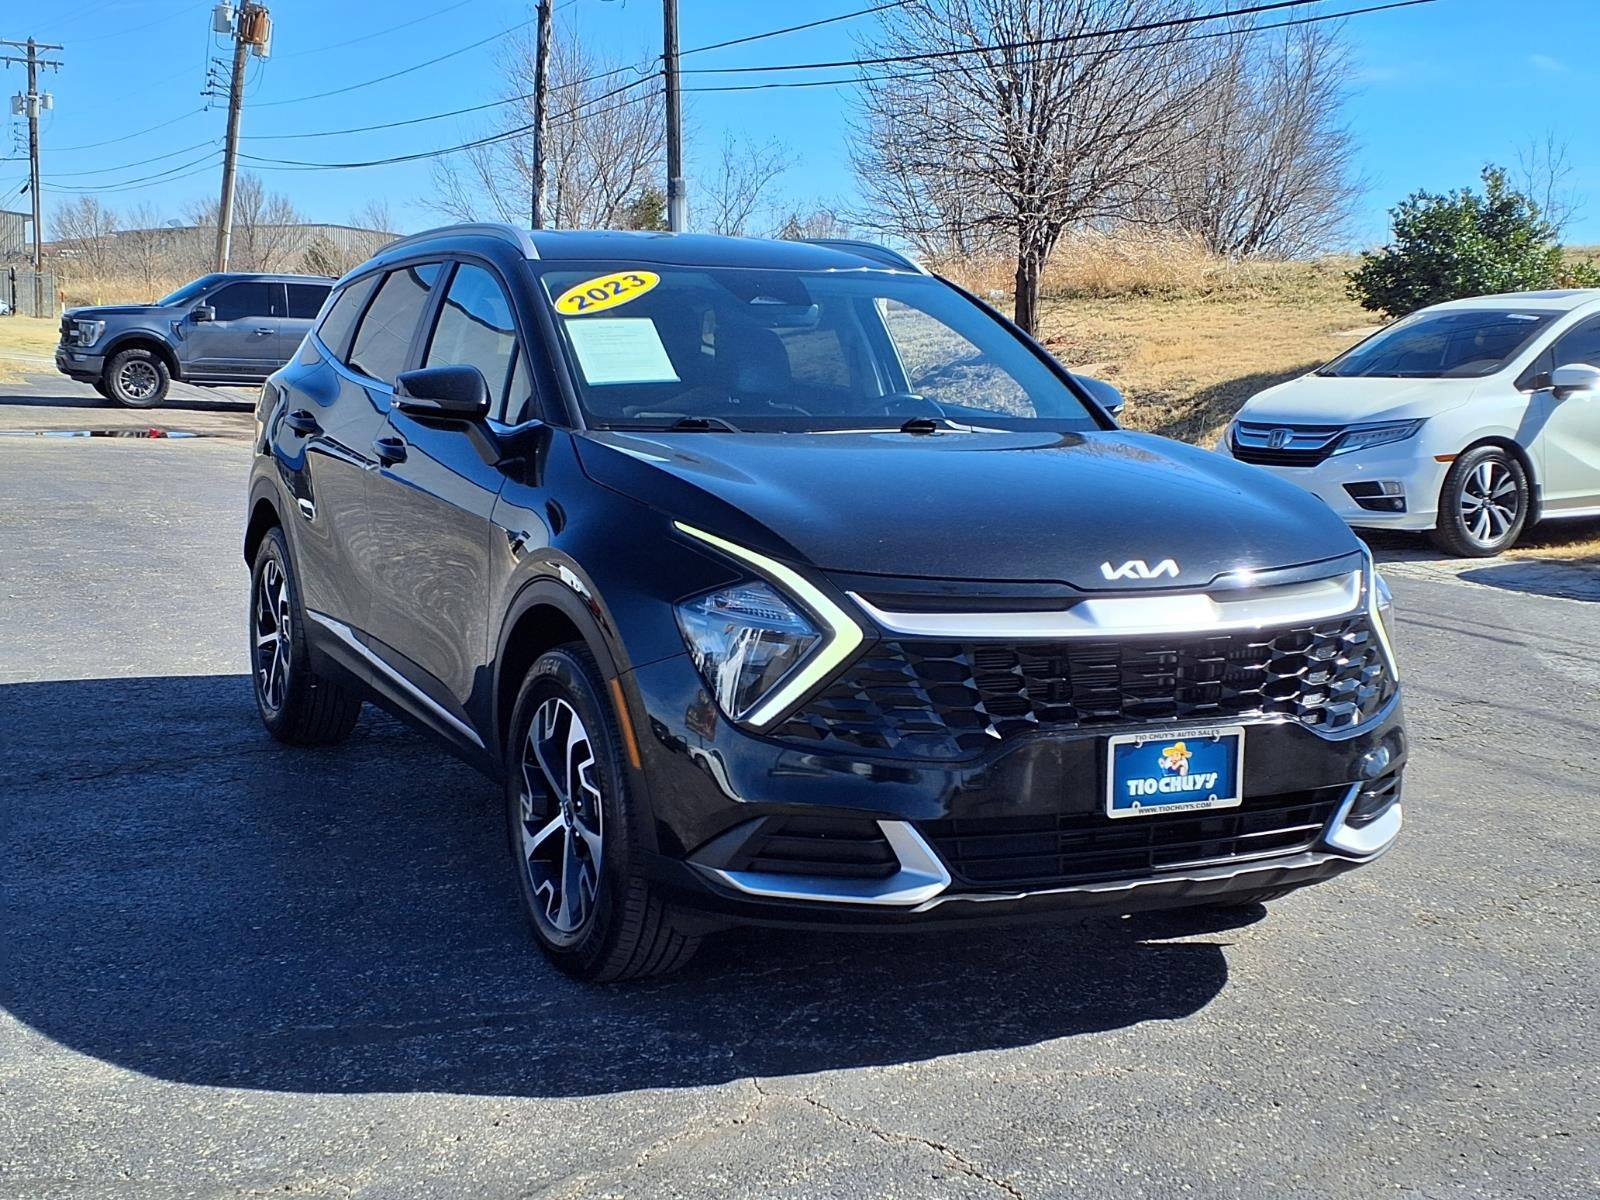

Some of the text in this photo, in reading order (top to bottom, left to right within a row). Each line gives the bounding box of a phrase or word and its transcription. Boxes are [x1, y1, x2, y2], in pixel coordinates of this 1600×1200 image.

[568, 274, 646, 310] 2023
[1100, 559, 1180, 580] KIA
[1149, 732, 1175, 740] CHUY'S
[1177, 730, 1197, 738] AUTO
[1198, 728, 1220, 737] SALES
[1127, 772, 1218, 796] TIO CHUY'S
[1138, 801, 1212, 815] WWW.TIOCHUYS.COM
